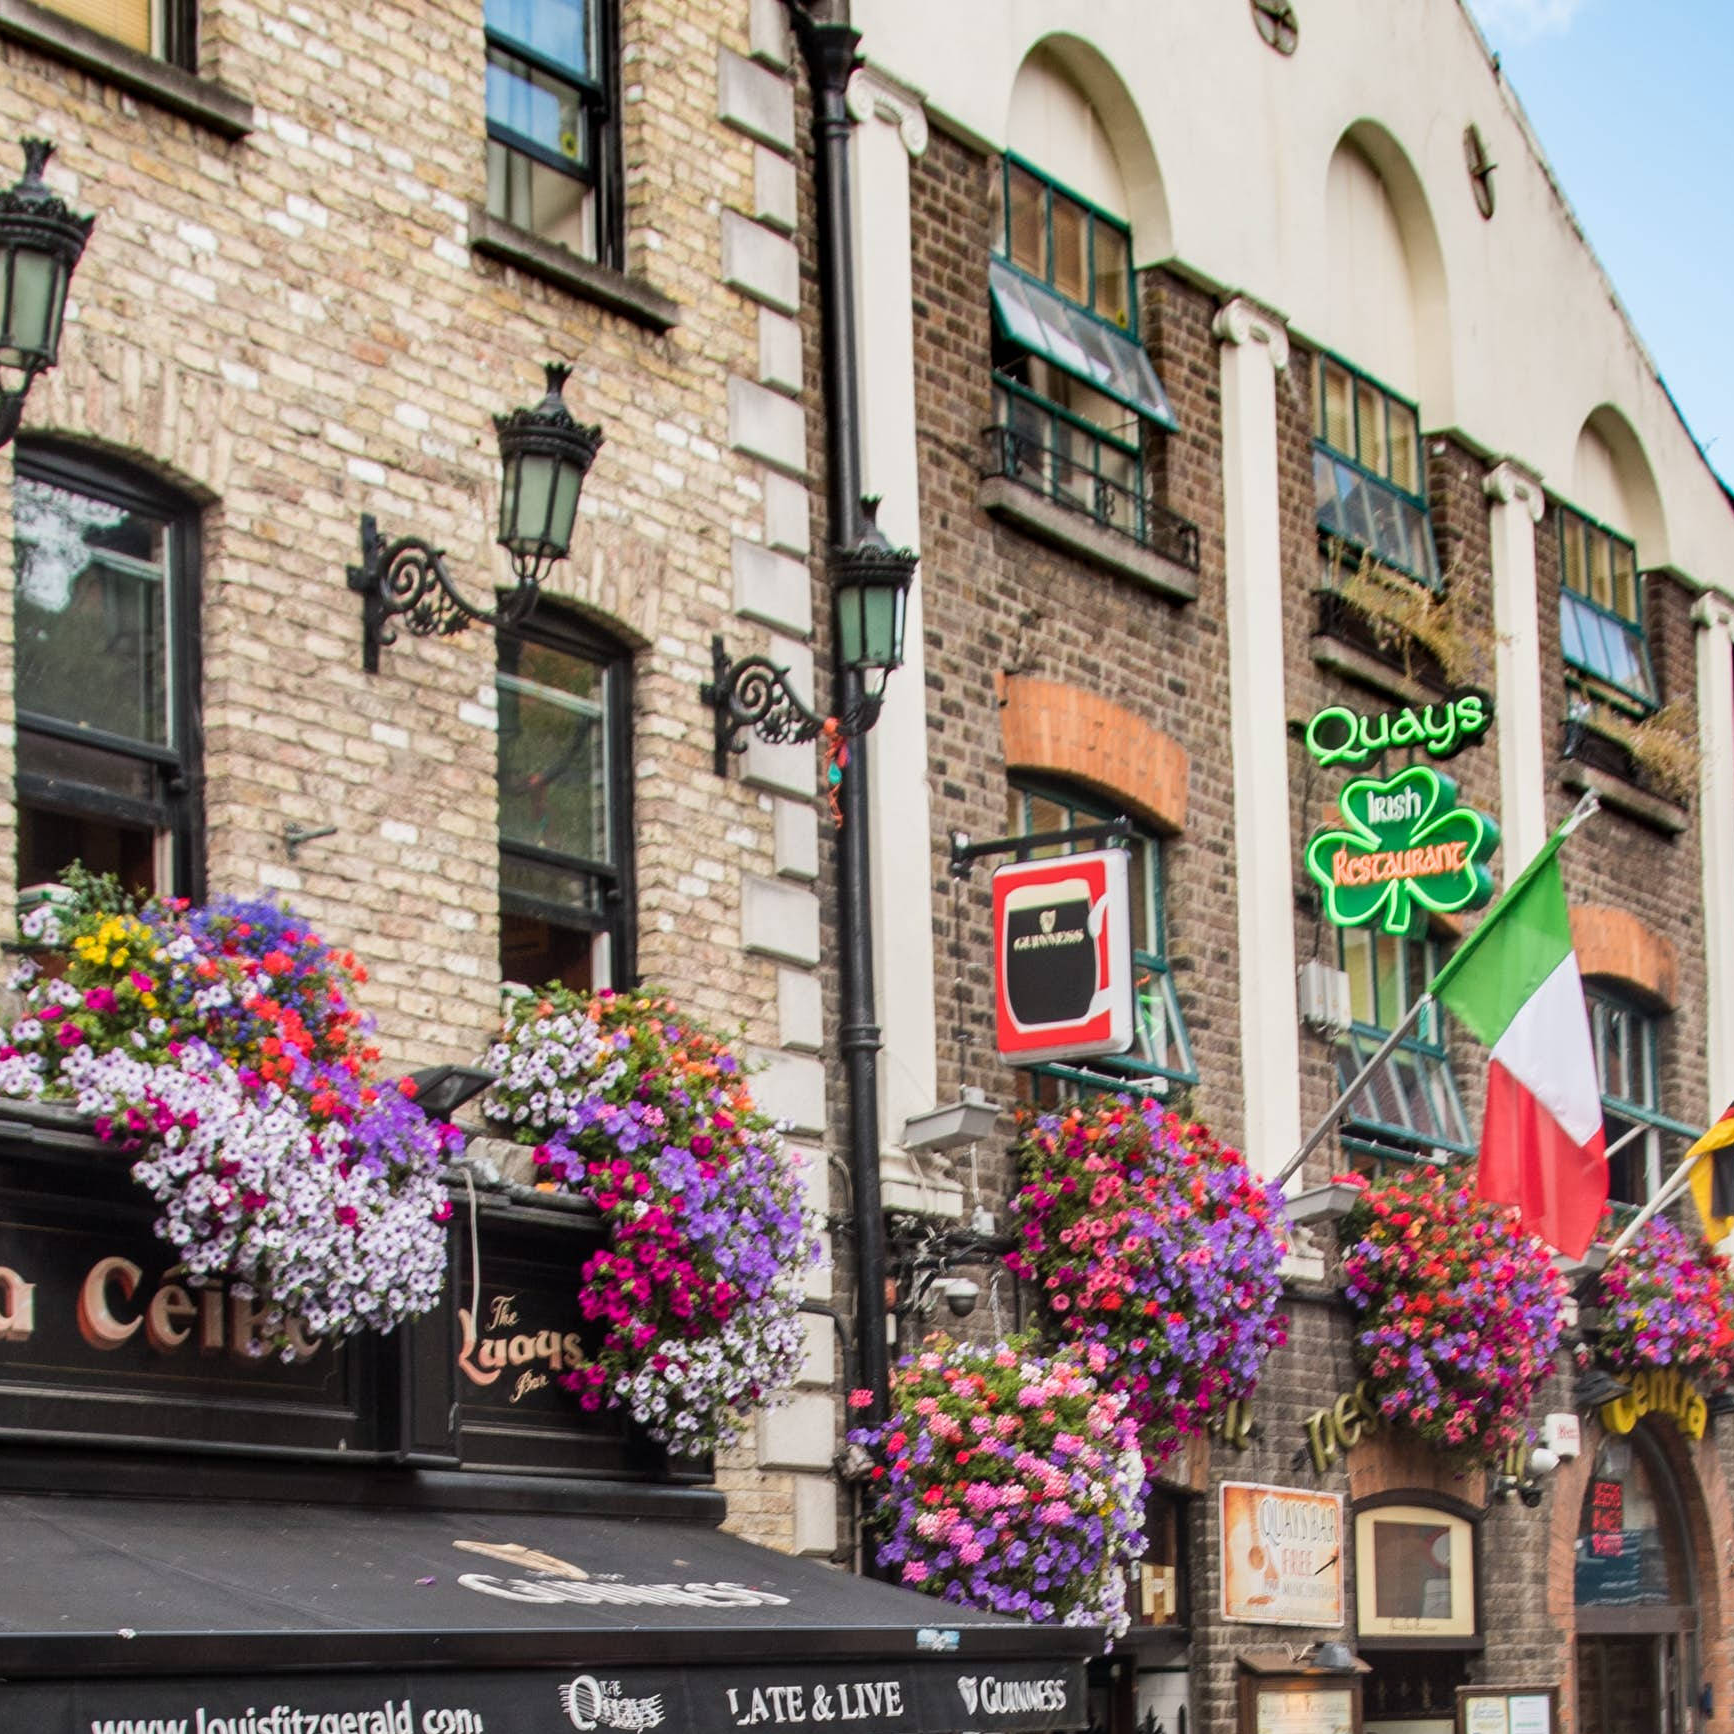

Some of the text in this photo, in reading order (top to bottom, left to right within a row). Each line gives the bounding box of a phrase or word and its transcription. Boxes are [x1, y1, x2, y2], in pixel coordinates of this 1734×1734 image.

[1306, 696, 1484, 766] Quays
[1013, 928, 1085, 952] GUINNESS
[486, 1294, 520, 1331] The
[1281, 1548, 1314, 1577] FREE
[726, 1681, 905, 1726] LATE & LIVE
[980, 1676, 1067, 1715] GUINNESS
